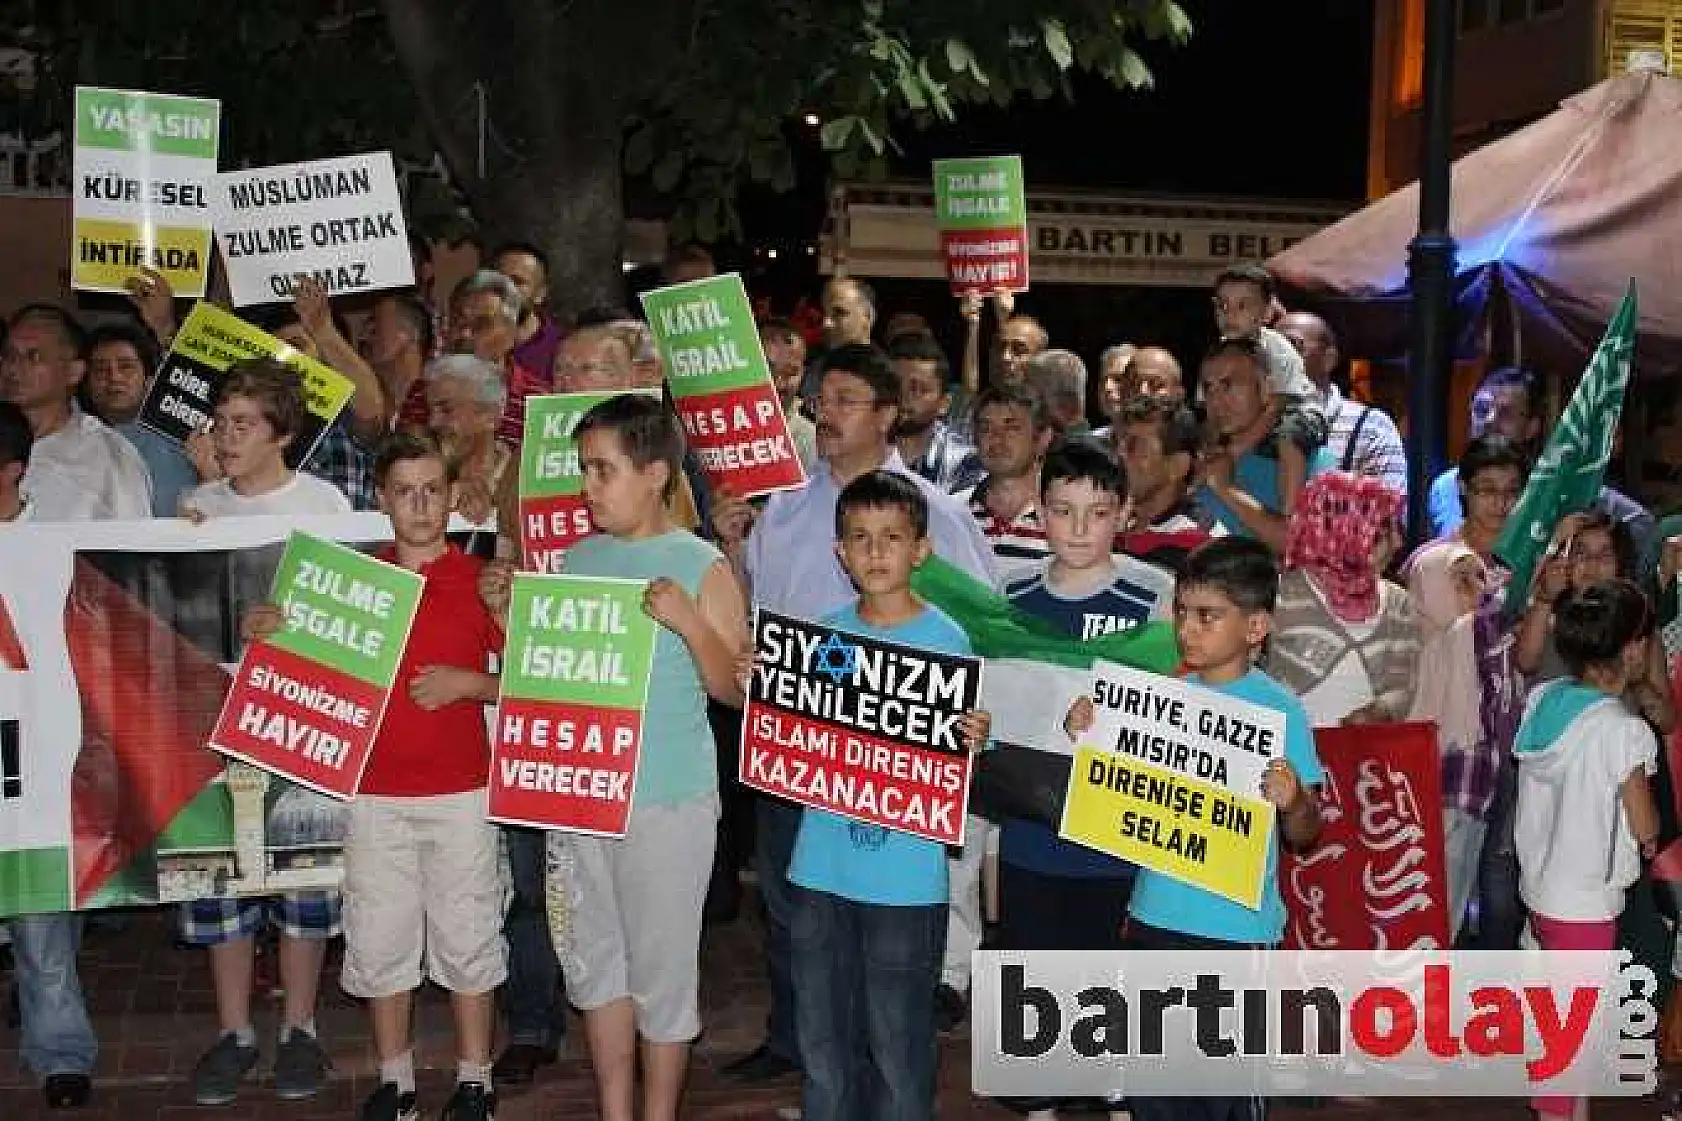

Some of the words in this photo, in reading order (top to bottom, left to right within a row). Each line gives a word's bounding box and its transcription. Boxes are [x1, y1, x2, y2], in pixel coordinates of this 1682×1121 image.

[229, 168, 371, 209] MÜSLÜMAN
[224, 225, 305, 257] ZULME
[310, 213, 397, 247] ORTAK
[1037, 226, 1183, 256] BARTIN
[294, 561, 396, 619] ZULME
[529, 593, 628, 635] KATİL
[520, 635, 630, 686] İSRAİL
[249, 664, 371, 729] SİYONİZME
[757, 665, 960, 751] YENİLECEK
[1115, 727, 1228, 786] MISIR'DA
[1199, 710, 1274, 758] GAZZE
[500, 757, 631, 802] VERECEK
[750, 747, 956, 835] KAZANACAK
[844, 736, 962, 794] DİRENİŞ
[1088, 757, 1205, 819] DİRENİŞE
[1210, 795, 1252, 838] BİN
[1120, 810, 1208, 865] SELAM
